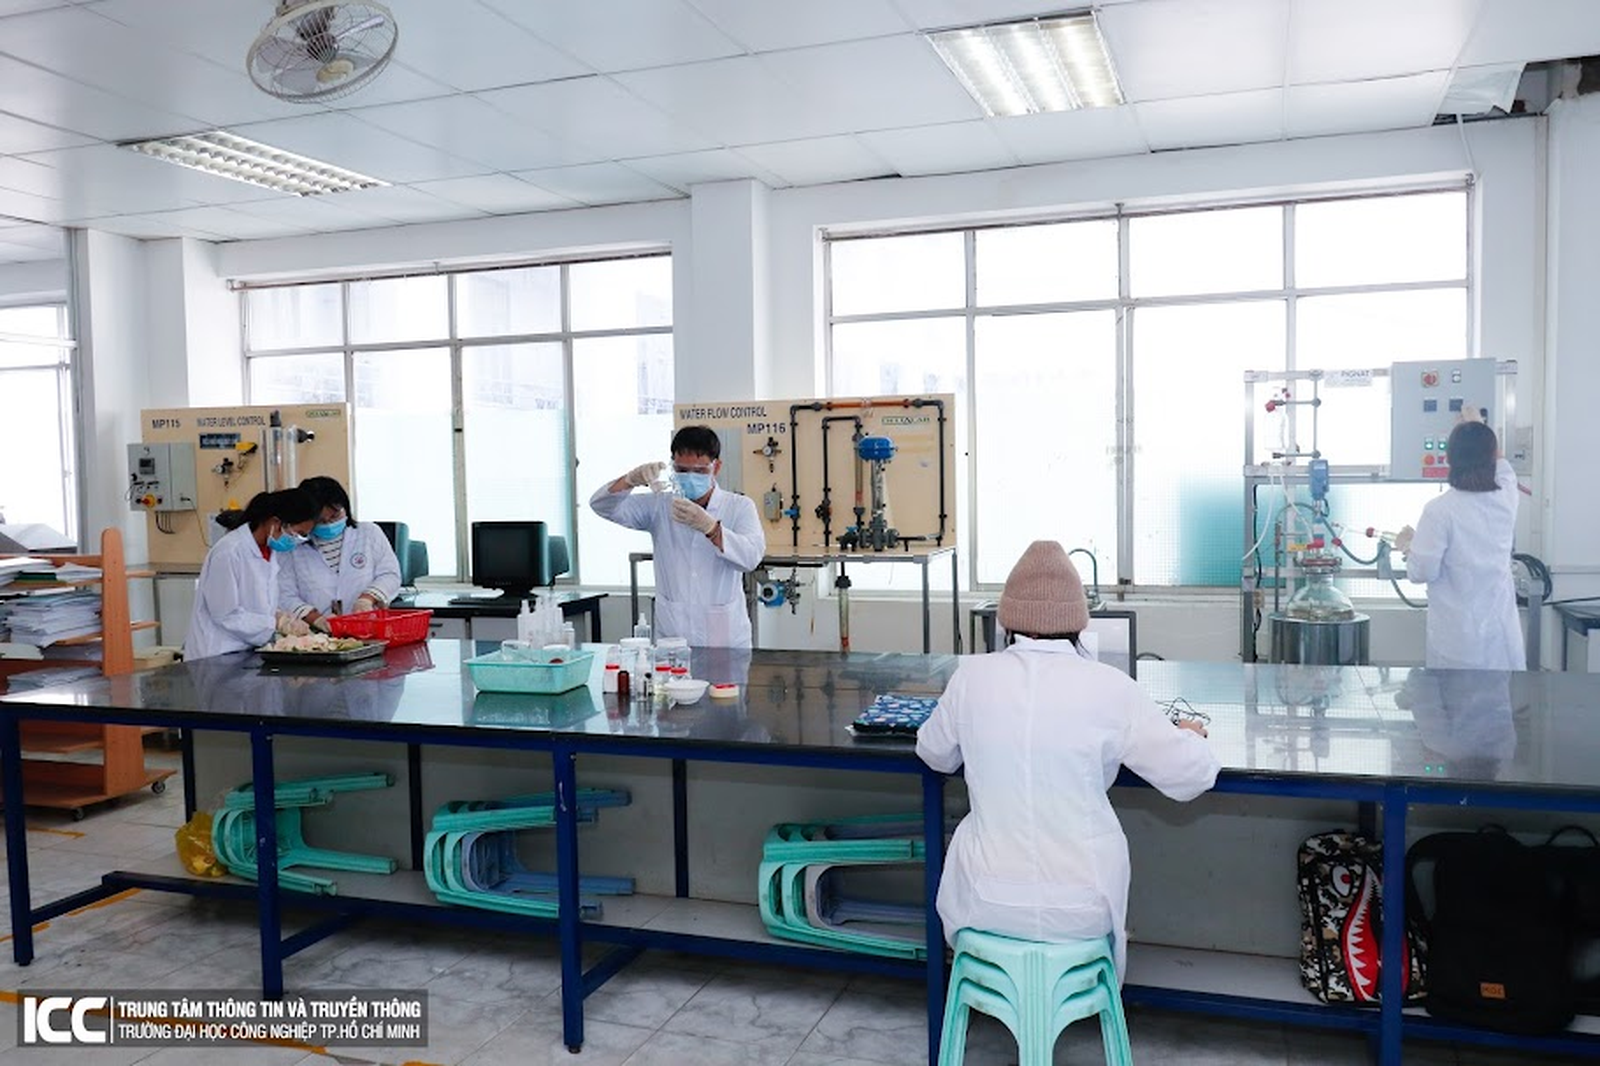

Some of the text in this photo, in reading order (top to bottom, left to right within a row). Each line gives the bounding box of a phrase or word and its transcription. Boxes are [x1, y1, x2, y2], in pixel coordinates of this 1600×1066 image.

[679, 406, 767, 420] WATER FLOW CONTROL
[152, 418, 181, 429] MP115
[197, 415, 266, 428] WATER LEVEL CONTROL
[747, 422, 786, 434] MP116
